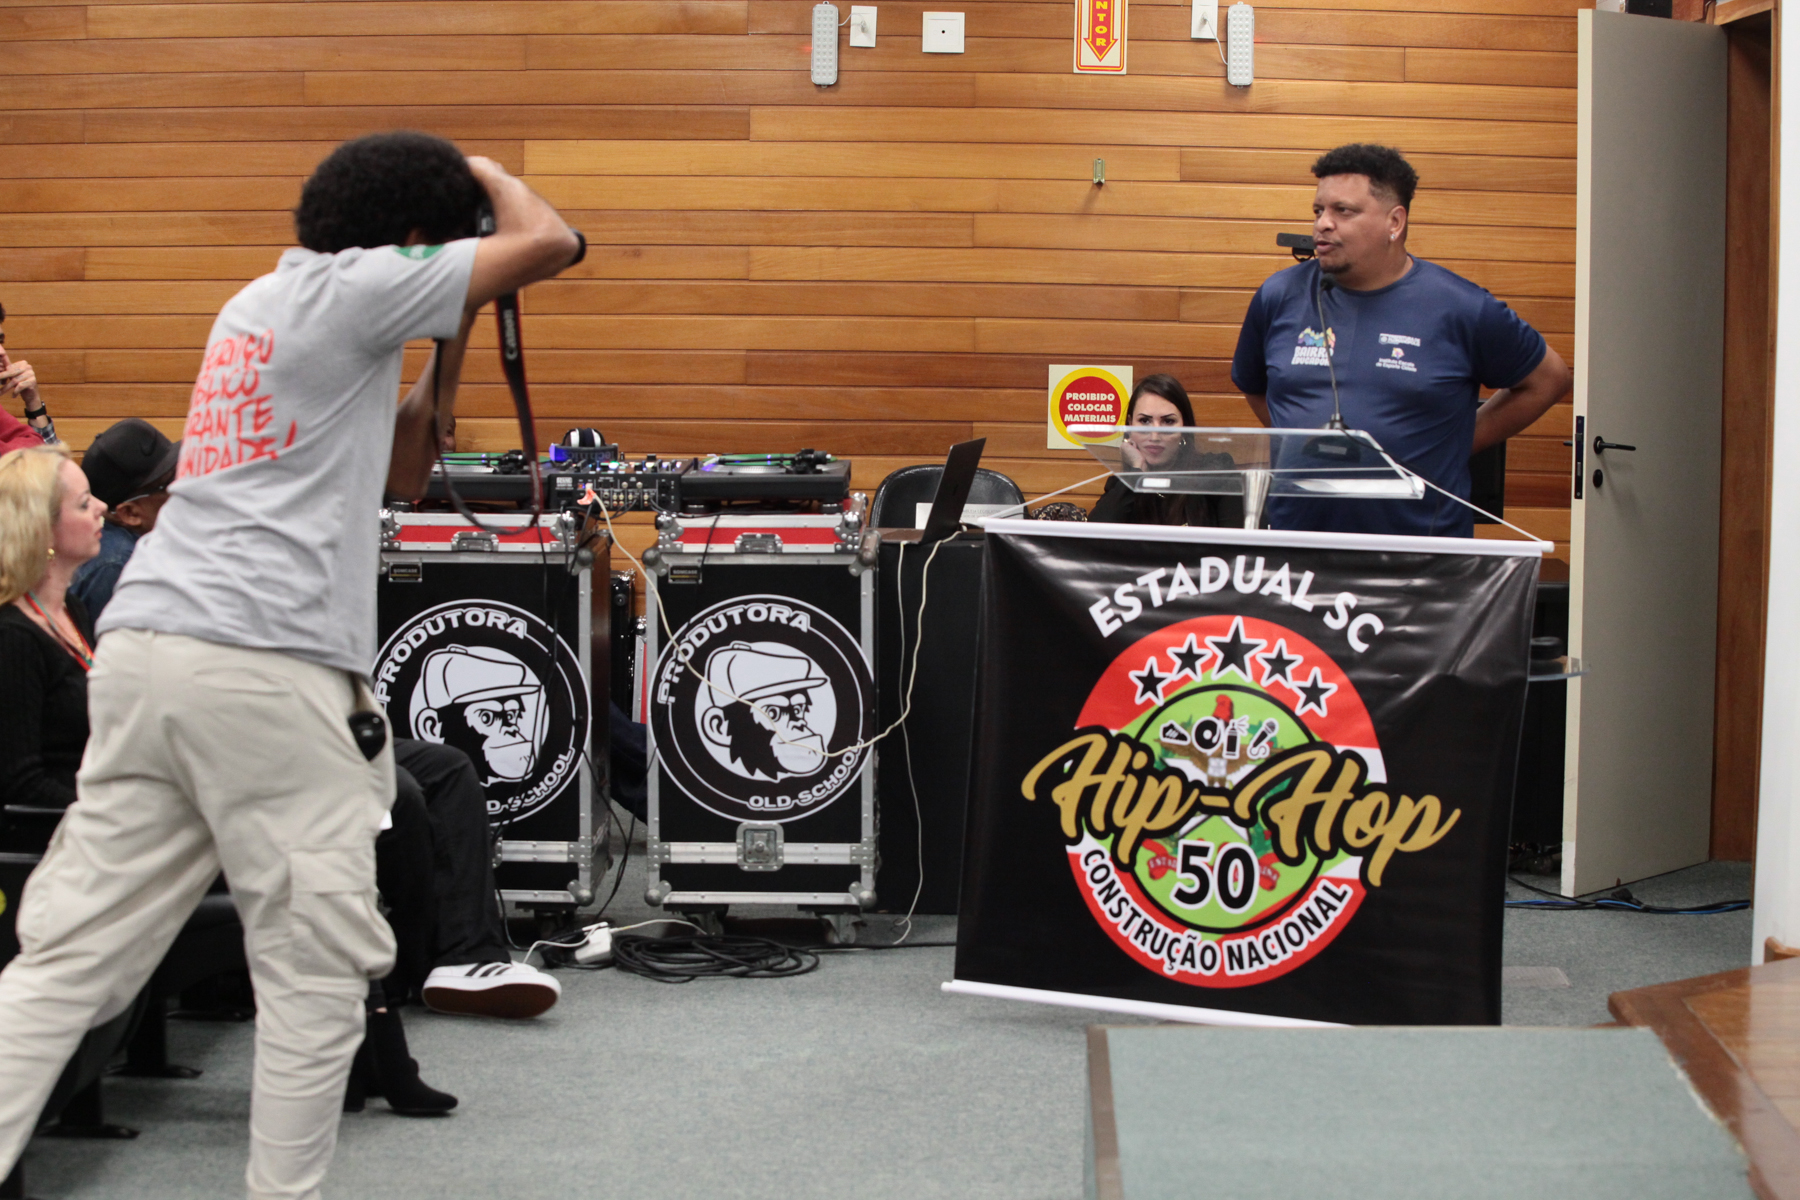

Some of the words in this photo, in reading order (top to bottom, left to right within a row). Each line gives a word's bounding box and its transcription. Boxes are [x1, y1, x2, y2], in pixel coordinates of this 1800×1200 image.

[1294, 346, 1334, 357] BAIRRO
[1064, 414, 1116, 423] MATERIAIS
[1066, 393, 1115, 401] PROIBIDO
[1067, 403, 1113, 412] COLOCAR
[1089, 555, 1315, 638] ESTADUAL
[1322, 591, 1384, 653] SC
[375, 608, 527, 703] PRODUTORA
[658, 605, 809, 704] PRODUTORA
[748, 795, 791, 808] OLD
[798, 741, 863, 805] SCHOOL
[1021, 734, 1461, 887] Hip-Hop
[1084, 850, 1217, 971] CONSTRUÇÃO
[1227, 885, 1348, 971] NACIONAL
[1172, 842, 1257, 911] 50
